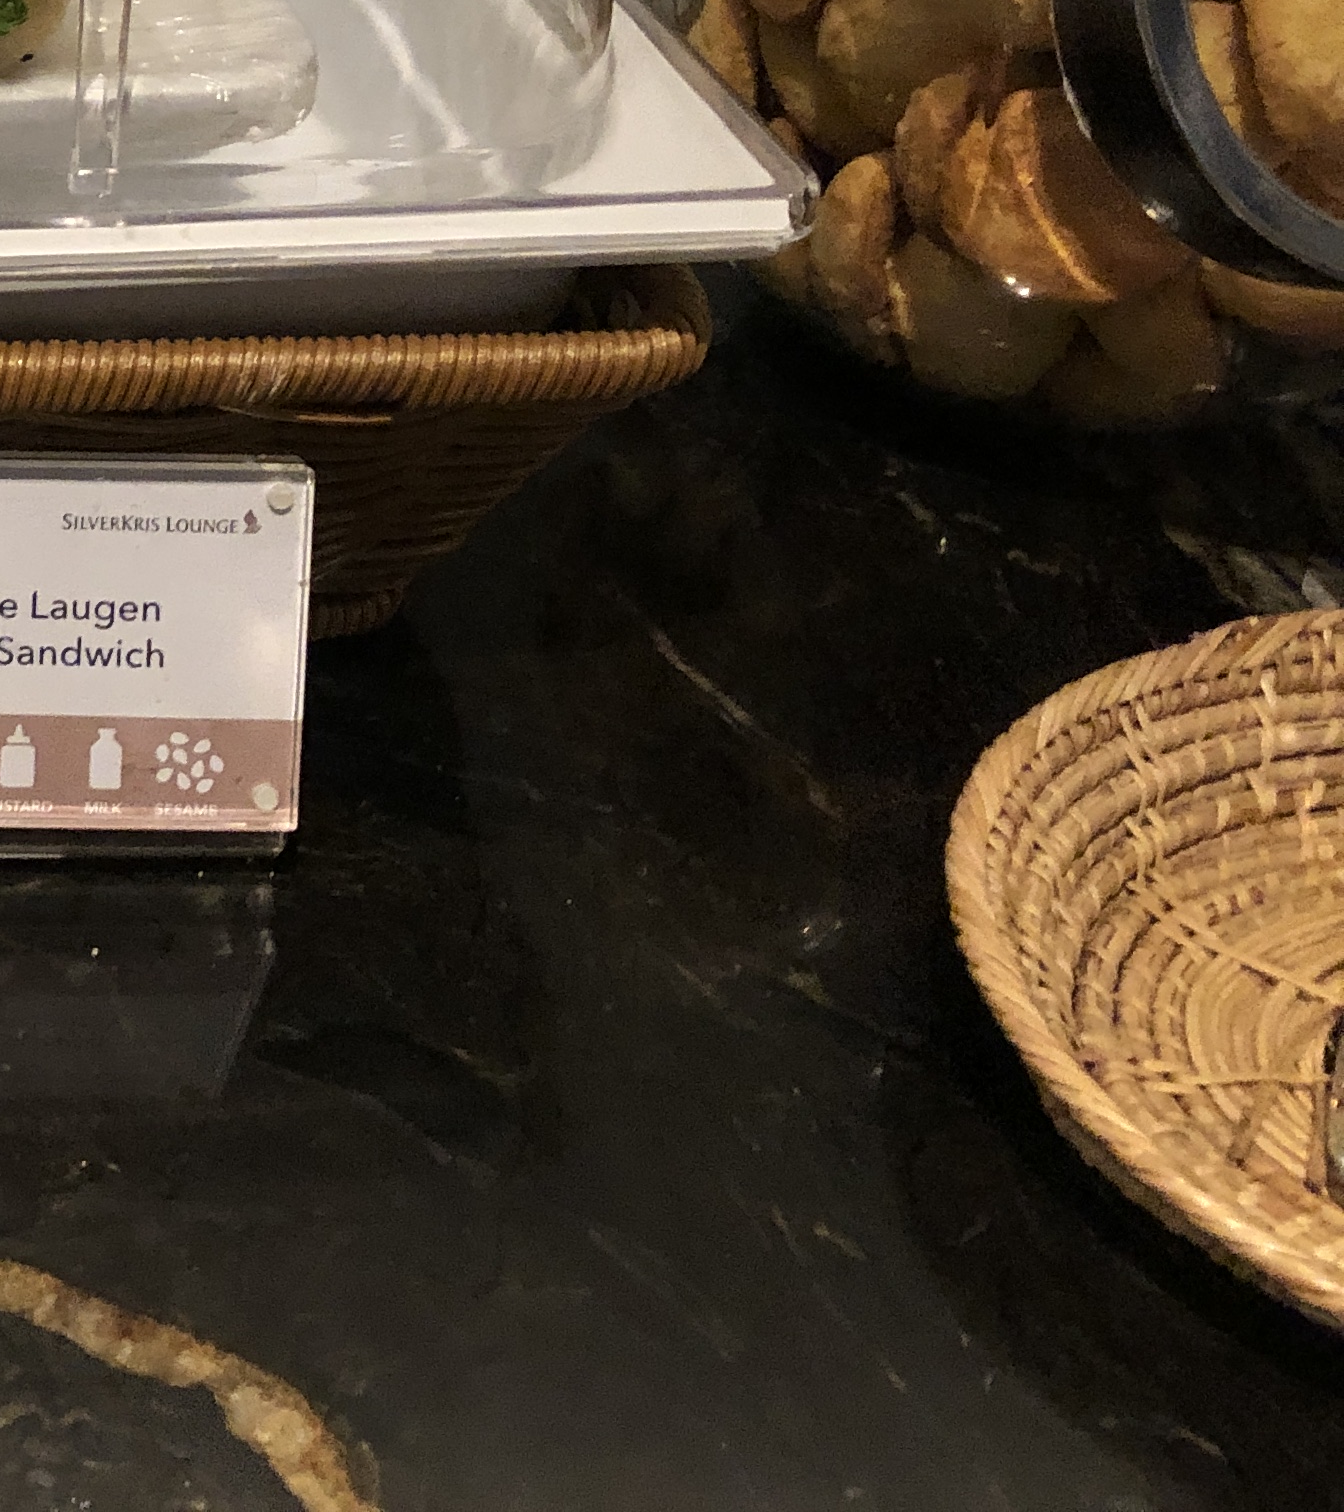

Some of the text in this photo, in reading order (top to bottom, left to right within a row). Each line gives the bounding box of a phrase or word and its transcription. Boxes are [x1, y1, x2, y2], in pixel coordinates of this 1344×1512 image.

[166, 515, 239, 535] LOUNGE
[30, 590, 162, 629] Laugen
[84, 800, 122, 816] MILK
[154, 802, 219, 818] SESAME
